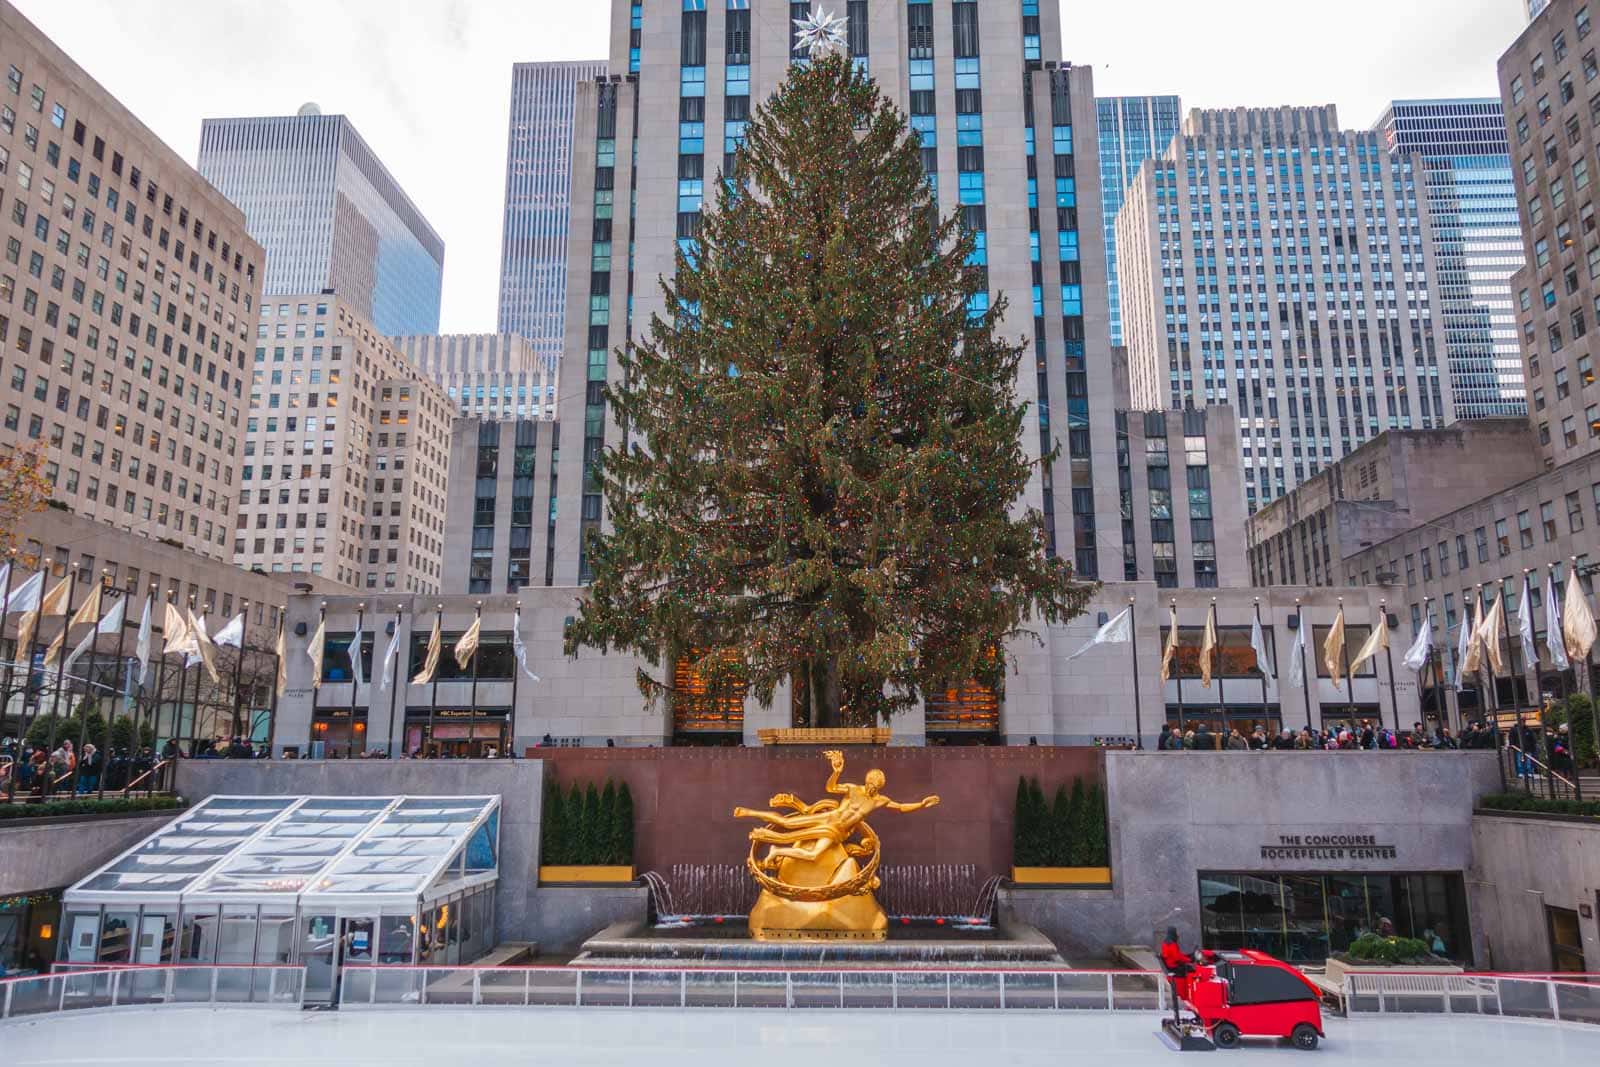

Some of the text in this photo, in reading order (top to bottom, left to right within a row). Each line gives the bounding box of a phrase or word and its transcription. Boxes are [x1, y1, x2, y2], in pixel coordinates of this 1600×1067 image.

[1280, 835, 1376, 845] THE CONCOURSE
[1261, 848, 1396, 859] ROCKEFELLER CENTER
